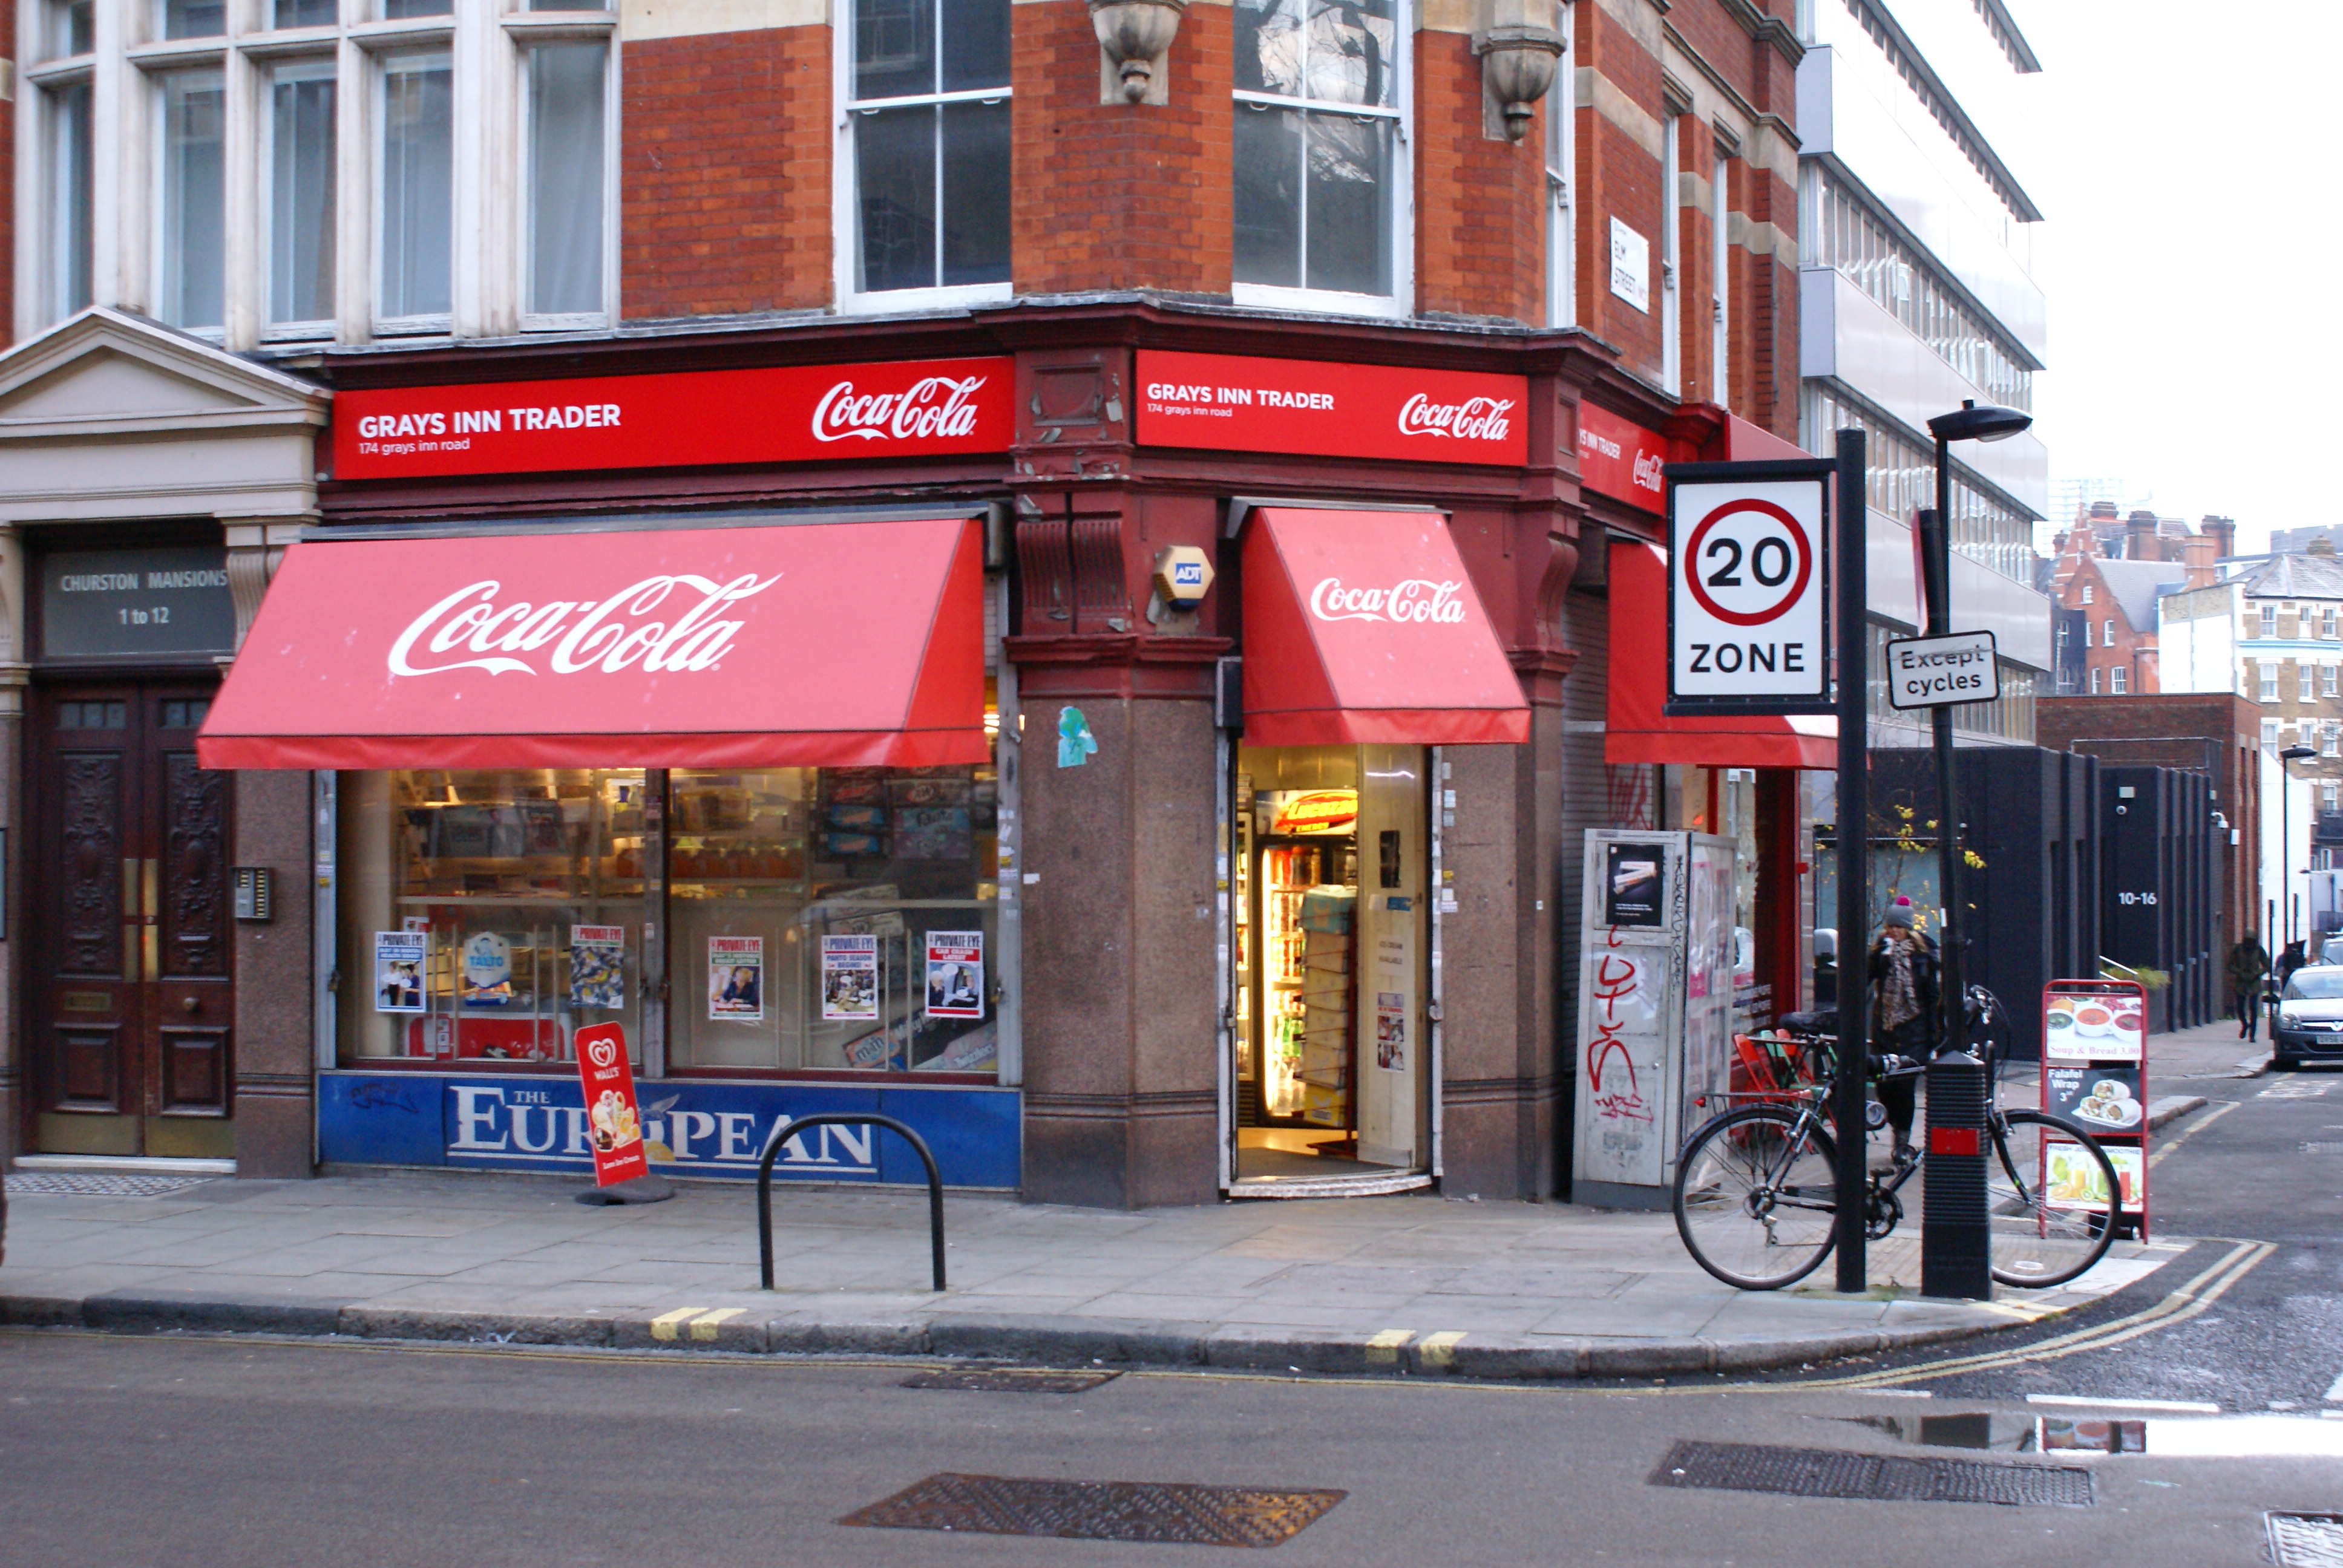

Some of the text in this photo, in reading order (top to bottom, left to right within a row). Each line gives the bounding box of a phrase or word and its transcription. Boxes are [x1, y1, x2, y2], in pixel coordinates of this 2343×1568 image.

[1147, 382, 1334, 410] GRAYS INN TRADER
[812, 376, 988, 442] Coca-Cola
[1147, 403, 1233, 417] 174 grays inn road
[1398, 393, 1515, 441] Coca-Cola
[359, 404, 621, 438] GRAYS INN TRADER
[359, 438, 470, 456] 174 grays inn road
[1598, 436, 1620, 460] TRADER
[1706, 537, 1792, 587] 20
[61, 570, 228, 592] CHURSTON MANSIONS
[1176, 566, 1202, 580] ADT
[1310, 578, 1464, 622] Coca-Cola
[120, 607, 169, 624] 1 to 12
[388, 572, 784, 676] Coca-Cola
[1690, 642, 1804, 673] ZONE
[1901, 644, 1984, 670] Except
[1907, 673, 1982, 699] cycles
[2119, 892, 2157, 904] 10-16
[383, 934, 423, 946] PRIVATE EYE
[580, 927, 622, 940] PRIVATE EYE
[935, 935, 980, 947] PRIVATE EYE
[717, 939, 760, 952] PRIVATE EYE
[830, 938, 874, 950] PRIVATE EYE
[2050, 1045, 2073, 1056] Soup
[2077, 1046, 2085, 1054] &
[2089, 1046, 2117, 1055] Bread
[2048, 1069, 2083, 1079] Falafel
[2051, 1079, 2080, 1091] Wrap
[514, 1090, 550, 1105] THE
